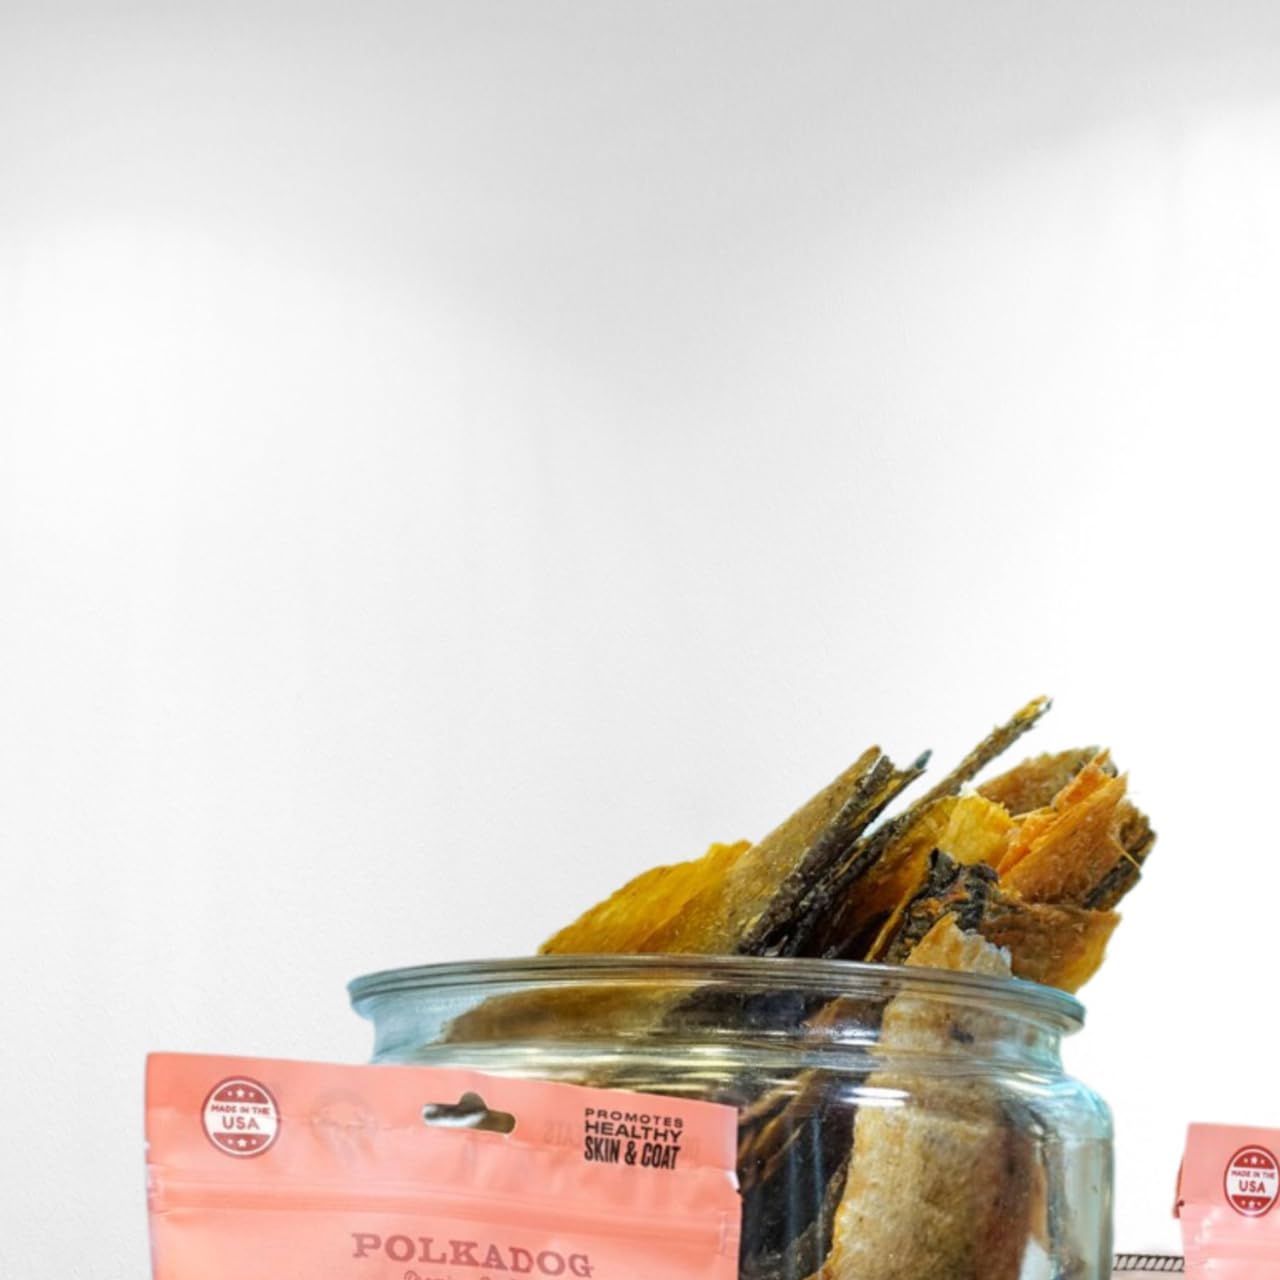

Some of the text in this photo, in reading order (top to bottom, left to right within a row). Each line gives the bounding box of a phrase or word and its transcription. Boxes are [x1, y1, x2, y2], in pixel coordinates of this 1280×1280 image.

[211, 1104, 237, 1113] MADE
[252, 1106, 271, 1115] THE
[584, 1107, 684, 1128] PROMOTES
[222, 1115, 260, 1130] USA
[584, 1120, 683, 1143] HEALTHY
[584, 1135, 682, 1170] SKIN & COAT
[1239, 1179, 1266, 1193] USA
[351, 1232, 594, 1279] POLKADOG
